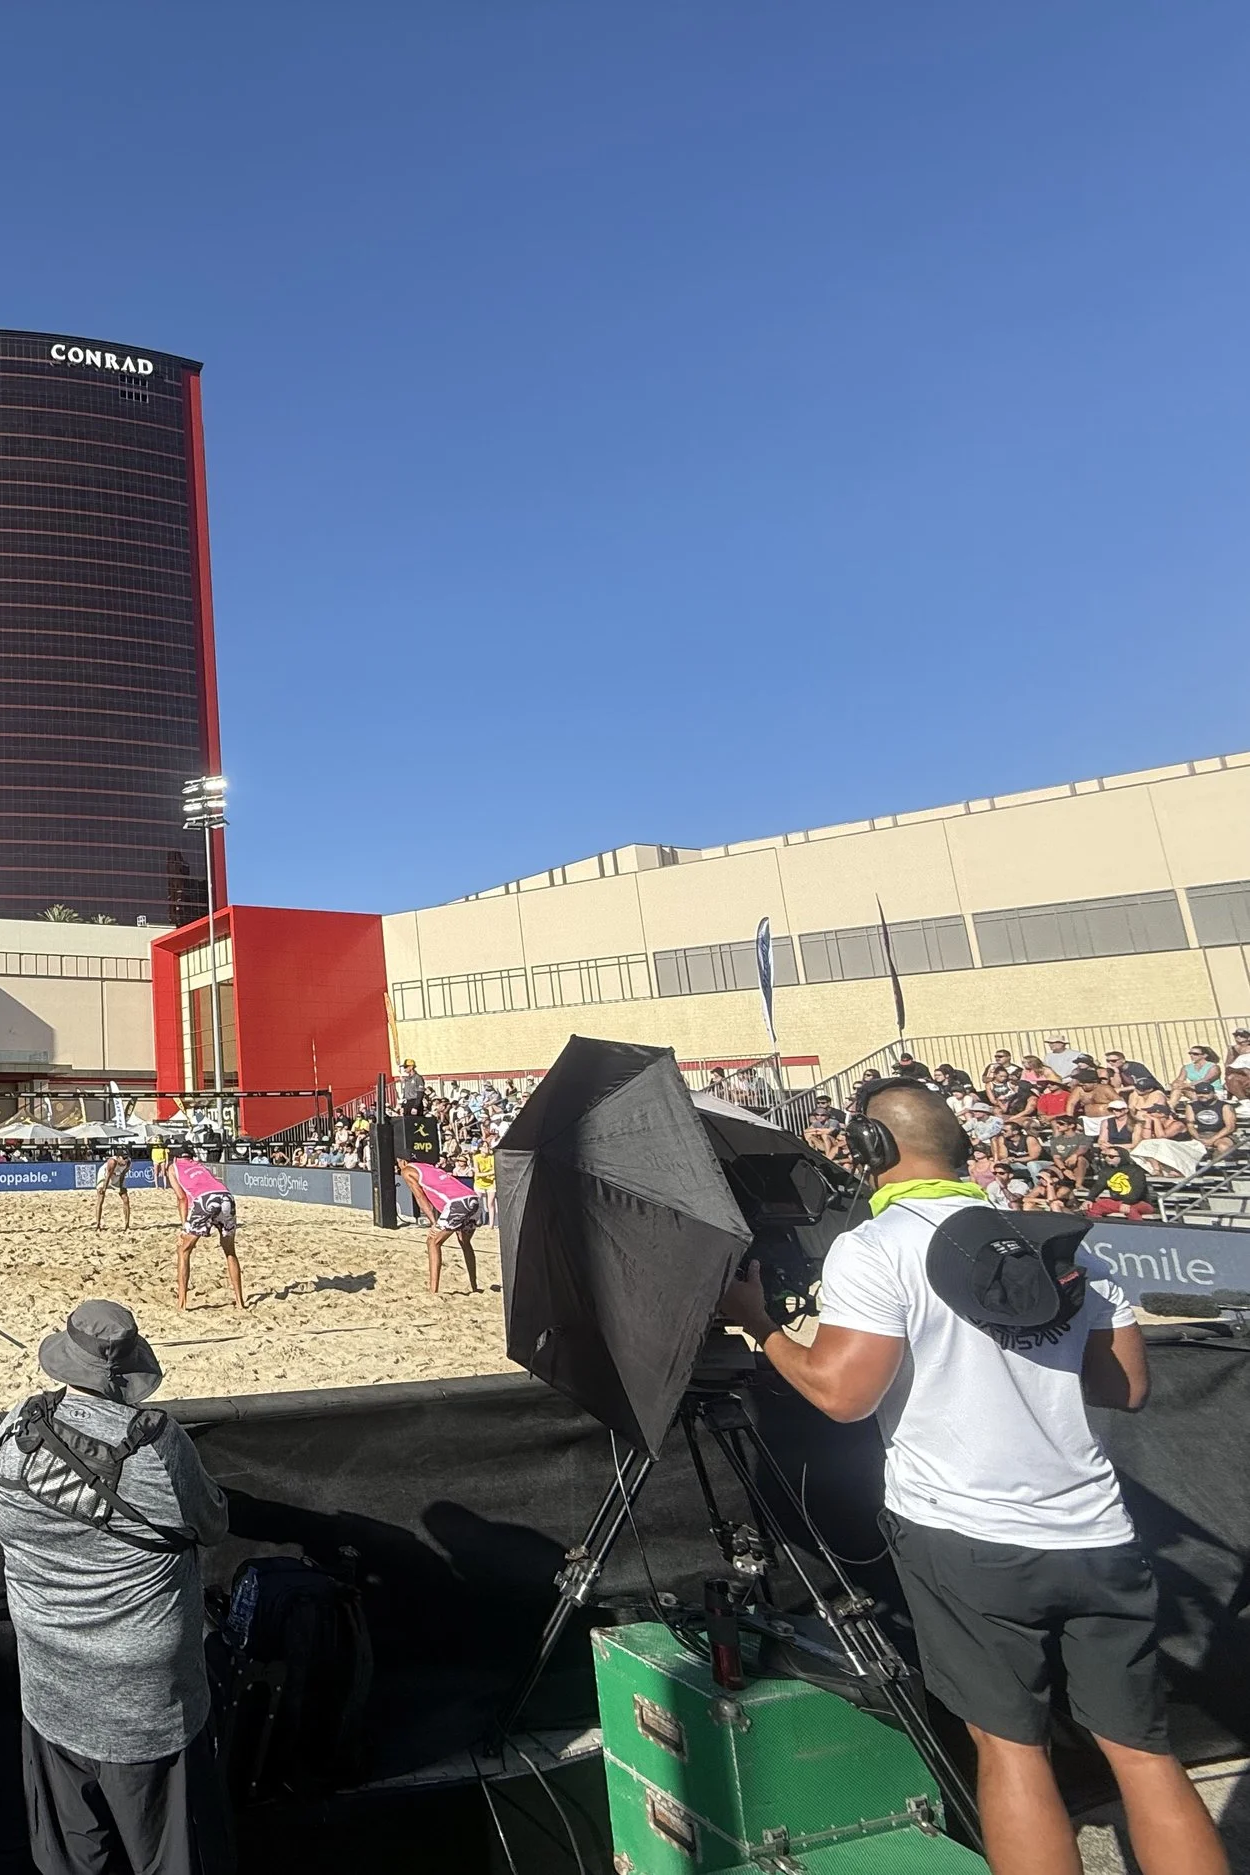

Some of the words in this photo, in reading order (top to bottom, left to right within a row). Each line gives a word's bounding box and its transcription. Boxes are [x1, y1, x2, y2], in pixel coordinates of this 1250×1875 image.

[50, 343, 154, 375] CONRAD
[413, 1141, 433, 1153] avp
[243, 1172, 279, 1189] Operation
[287, 1174, 309, 1192] Smile
[1094, 1242, 1216, 1286] Smile
